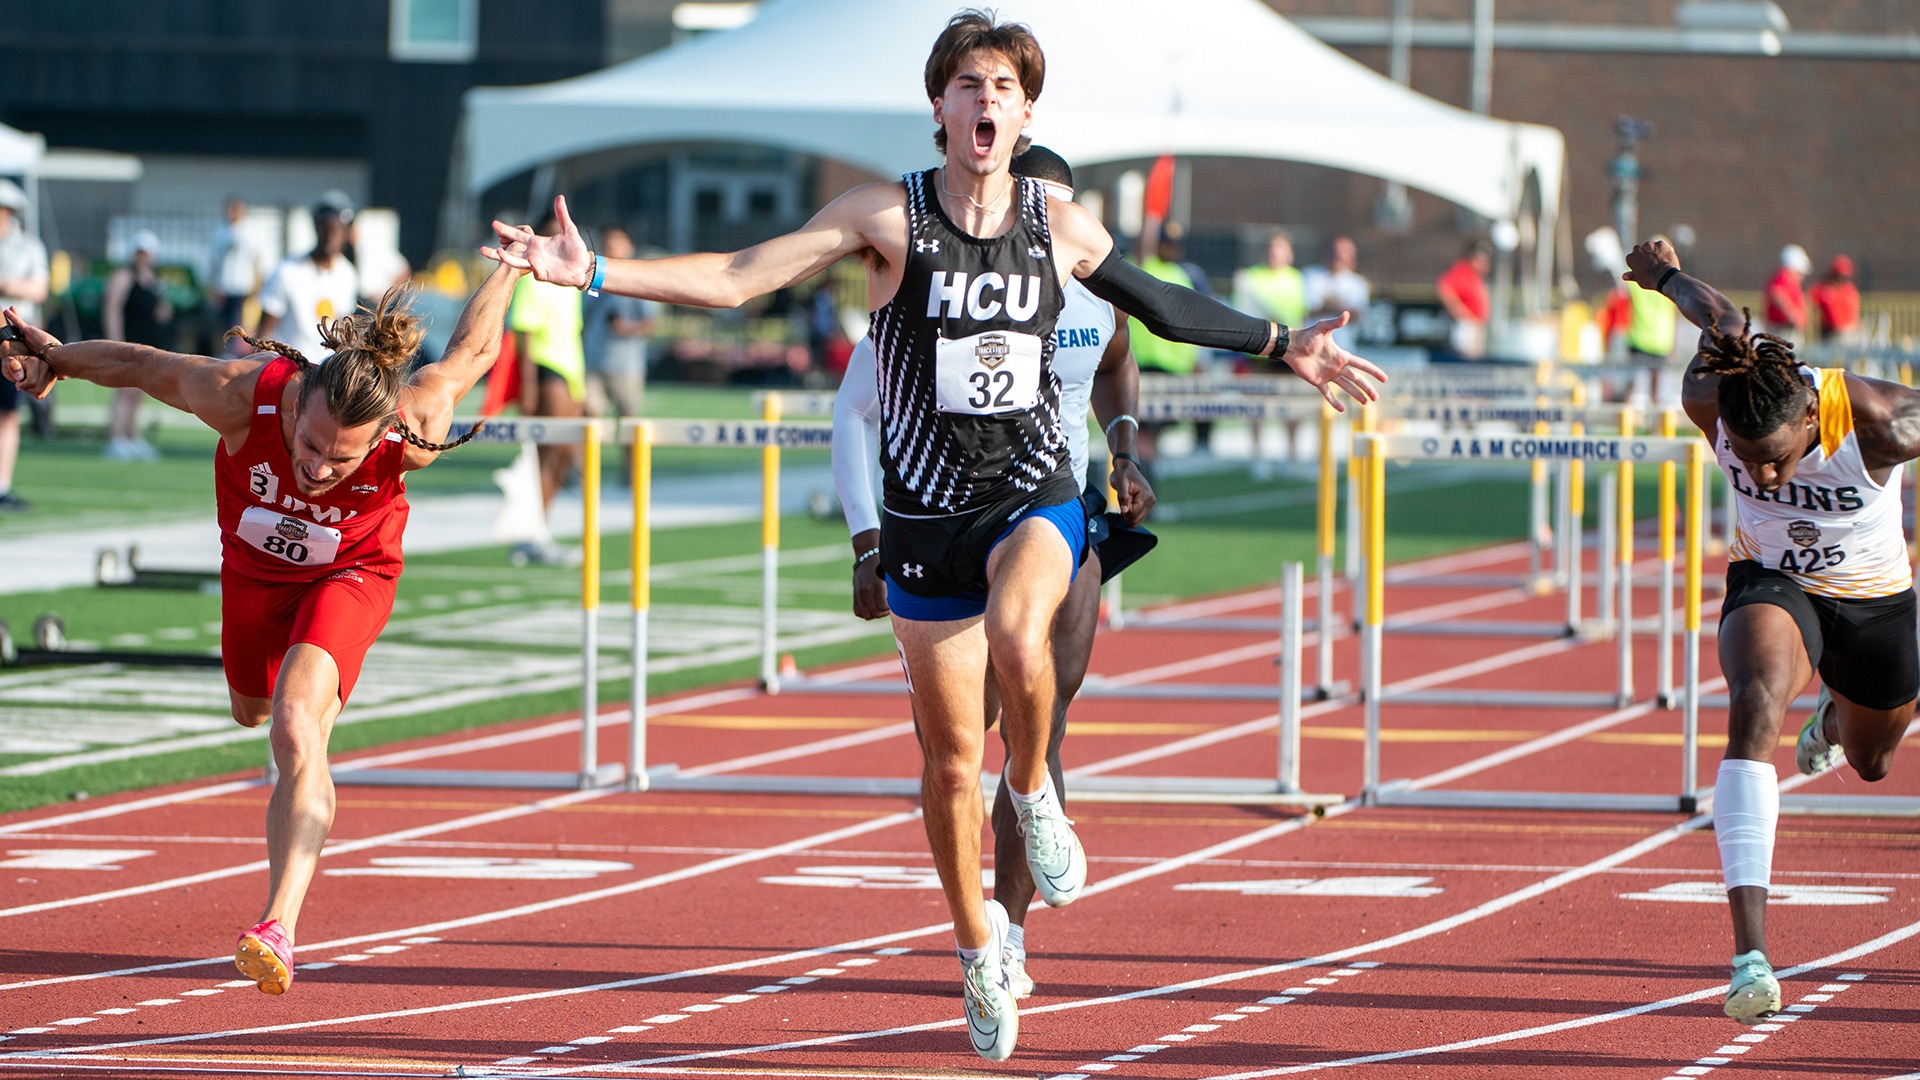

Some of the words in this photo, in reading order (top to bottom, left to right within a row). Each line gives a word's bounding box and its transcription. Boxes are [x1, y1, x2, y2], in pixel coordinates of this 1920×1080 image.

[926, 271, 1041, 322] HCU
[1056, 328, 1100, 348] EANS
[968, 370, 1014, 409] 32
[1452, 440, 1463, 456] A
[1470, 440, 1481, 456] &
[1490, 441, 1504, 457] M
[1511, 440, 1619, 459] COMMERCE
[251, 472, 268, 497] 3
[263, 535, 309, 563] 80
[1780, 544, 1846, 574] 425
